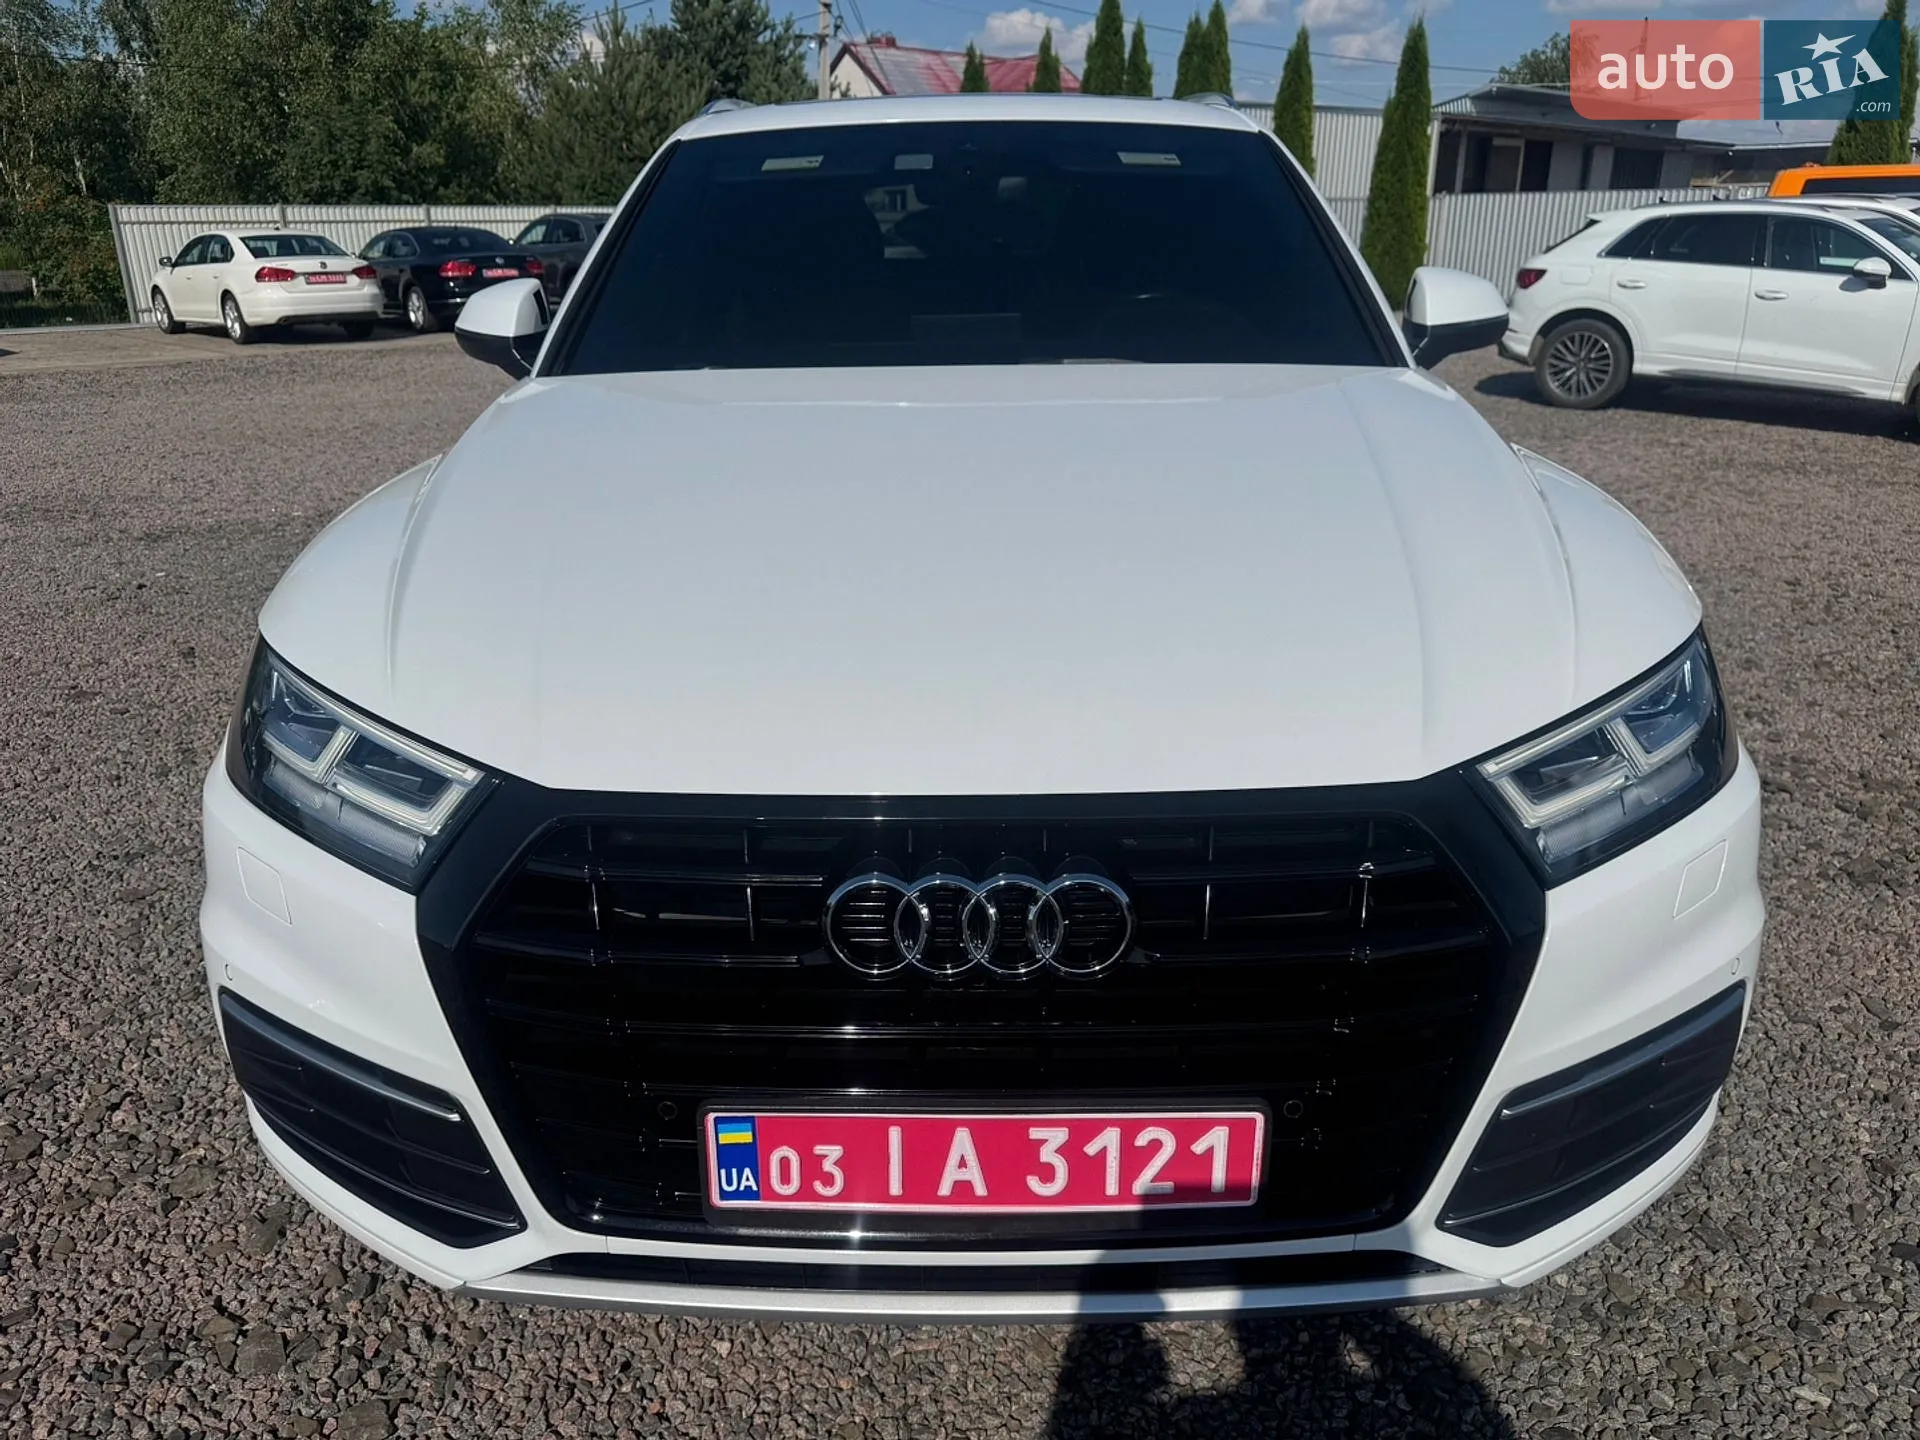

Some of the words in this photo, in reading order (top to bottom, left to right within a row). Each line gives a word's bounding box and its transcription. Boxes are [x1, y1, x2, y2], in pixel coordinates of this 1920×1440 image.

[719, 1167, 758, 1192] UA
[768, 1145, 844, 1196] 03
[1026, 1127, 1229, 1197] 3121
